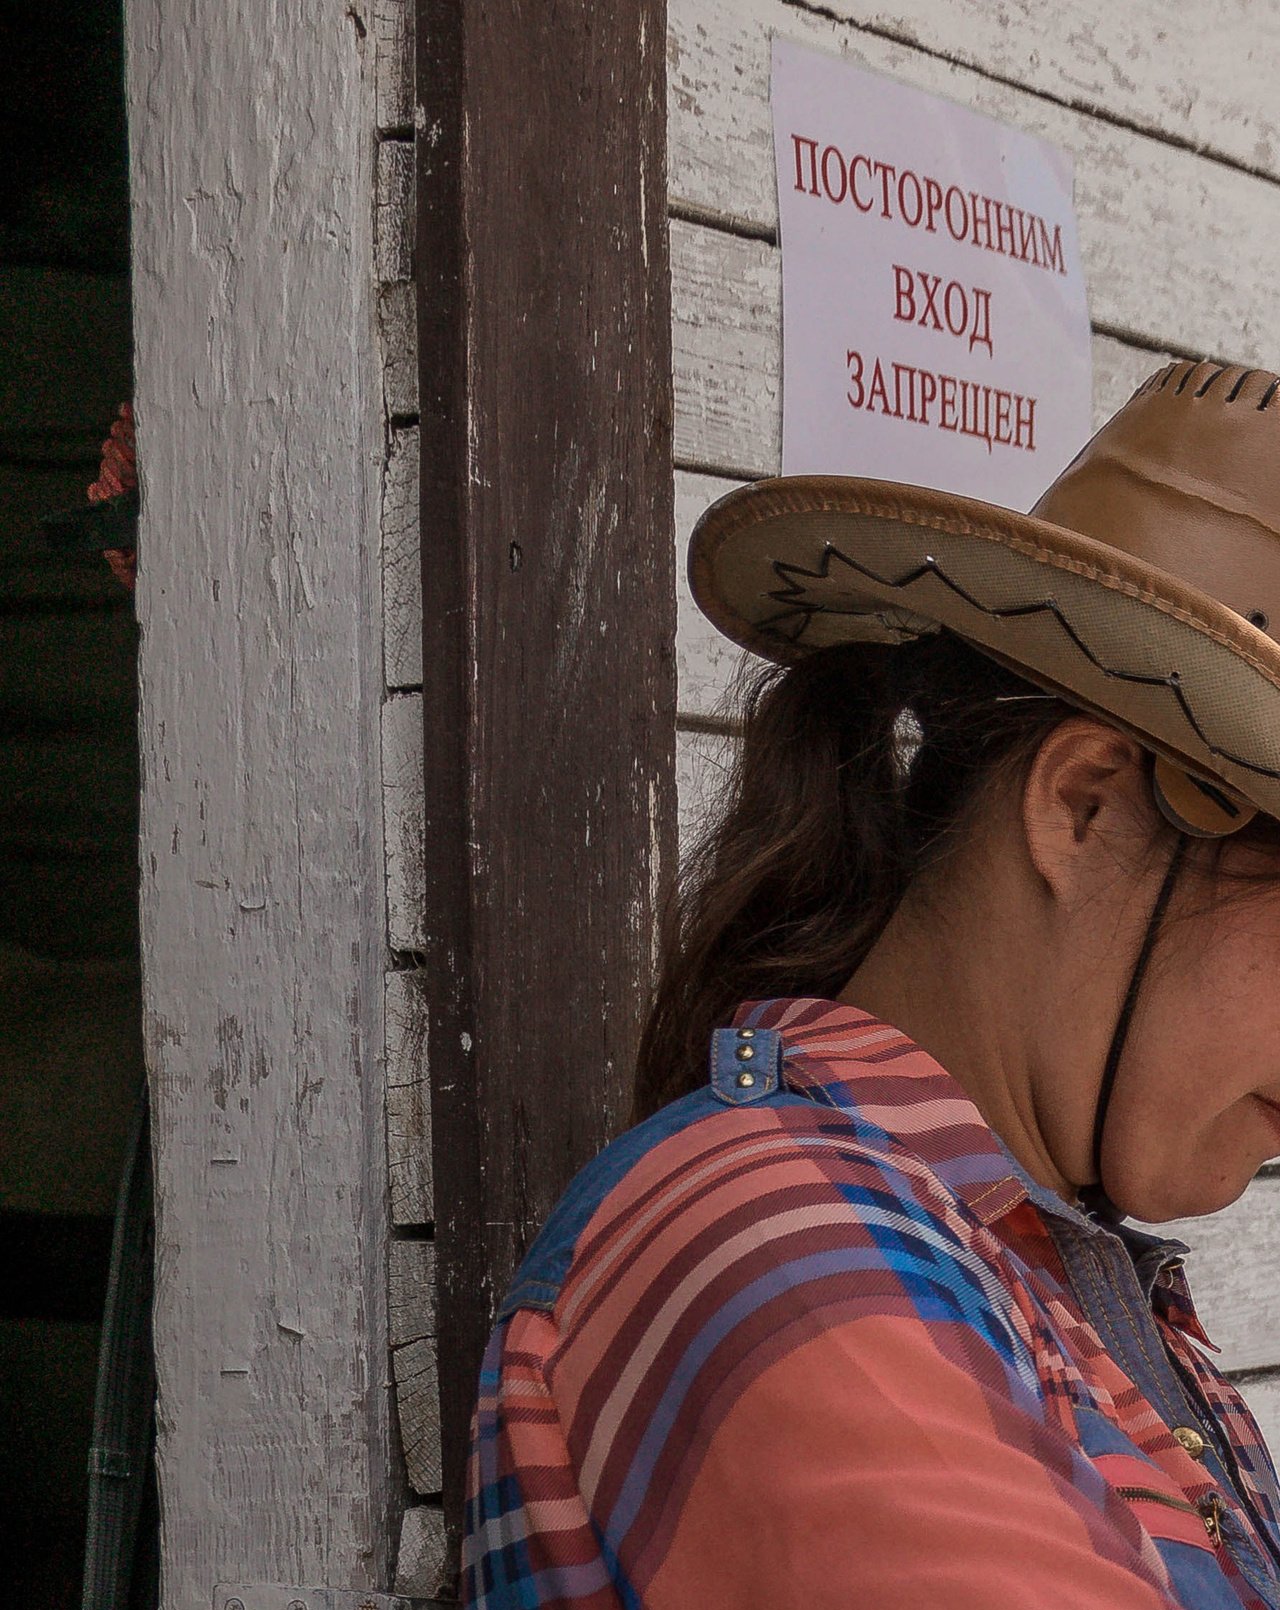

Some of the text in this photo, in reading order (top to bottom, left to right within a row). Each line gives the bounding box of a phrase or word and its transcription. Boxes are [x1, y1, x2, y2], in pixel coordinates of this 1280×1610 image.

[790, 133, 1068, 277] ПОСТОРОННИМ
[891, 264, 994, 359] ВХОД
[846, 349, 1038, 455] ЗАПРЕЩЕН
